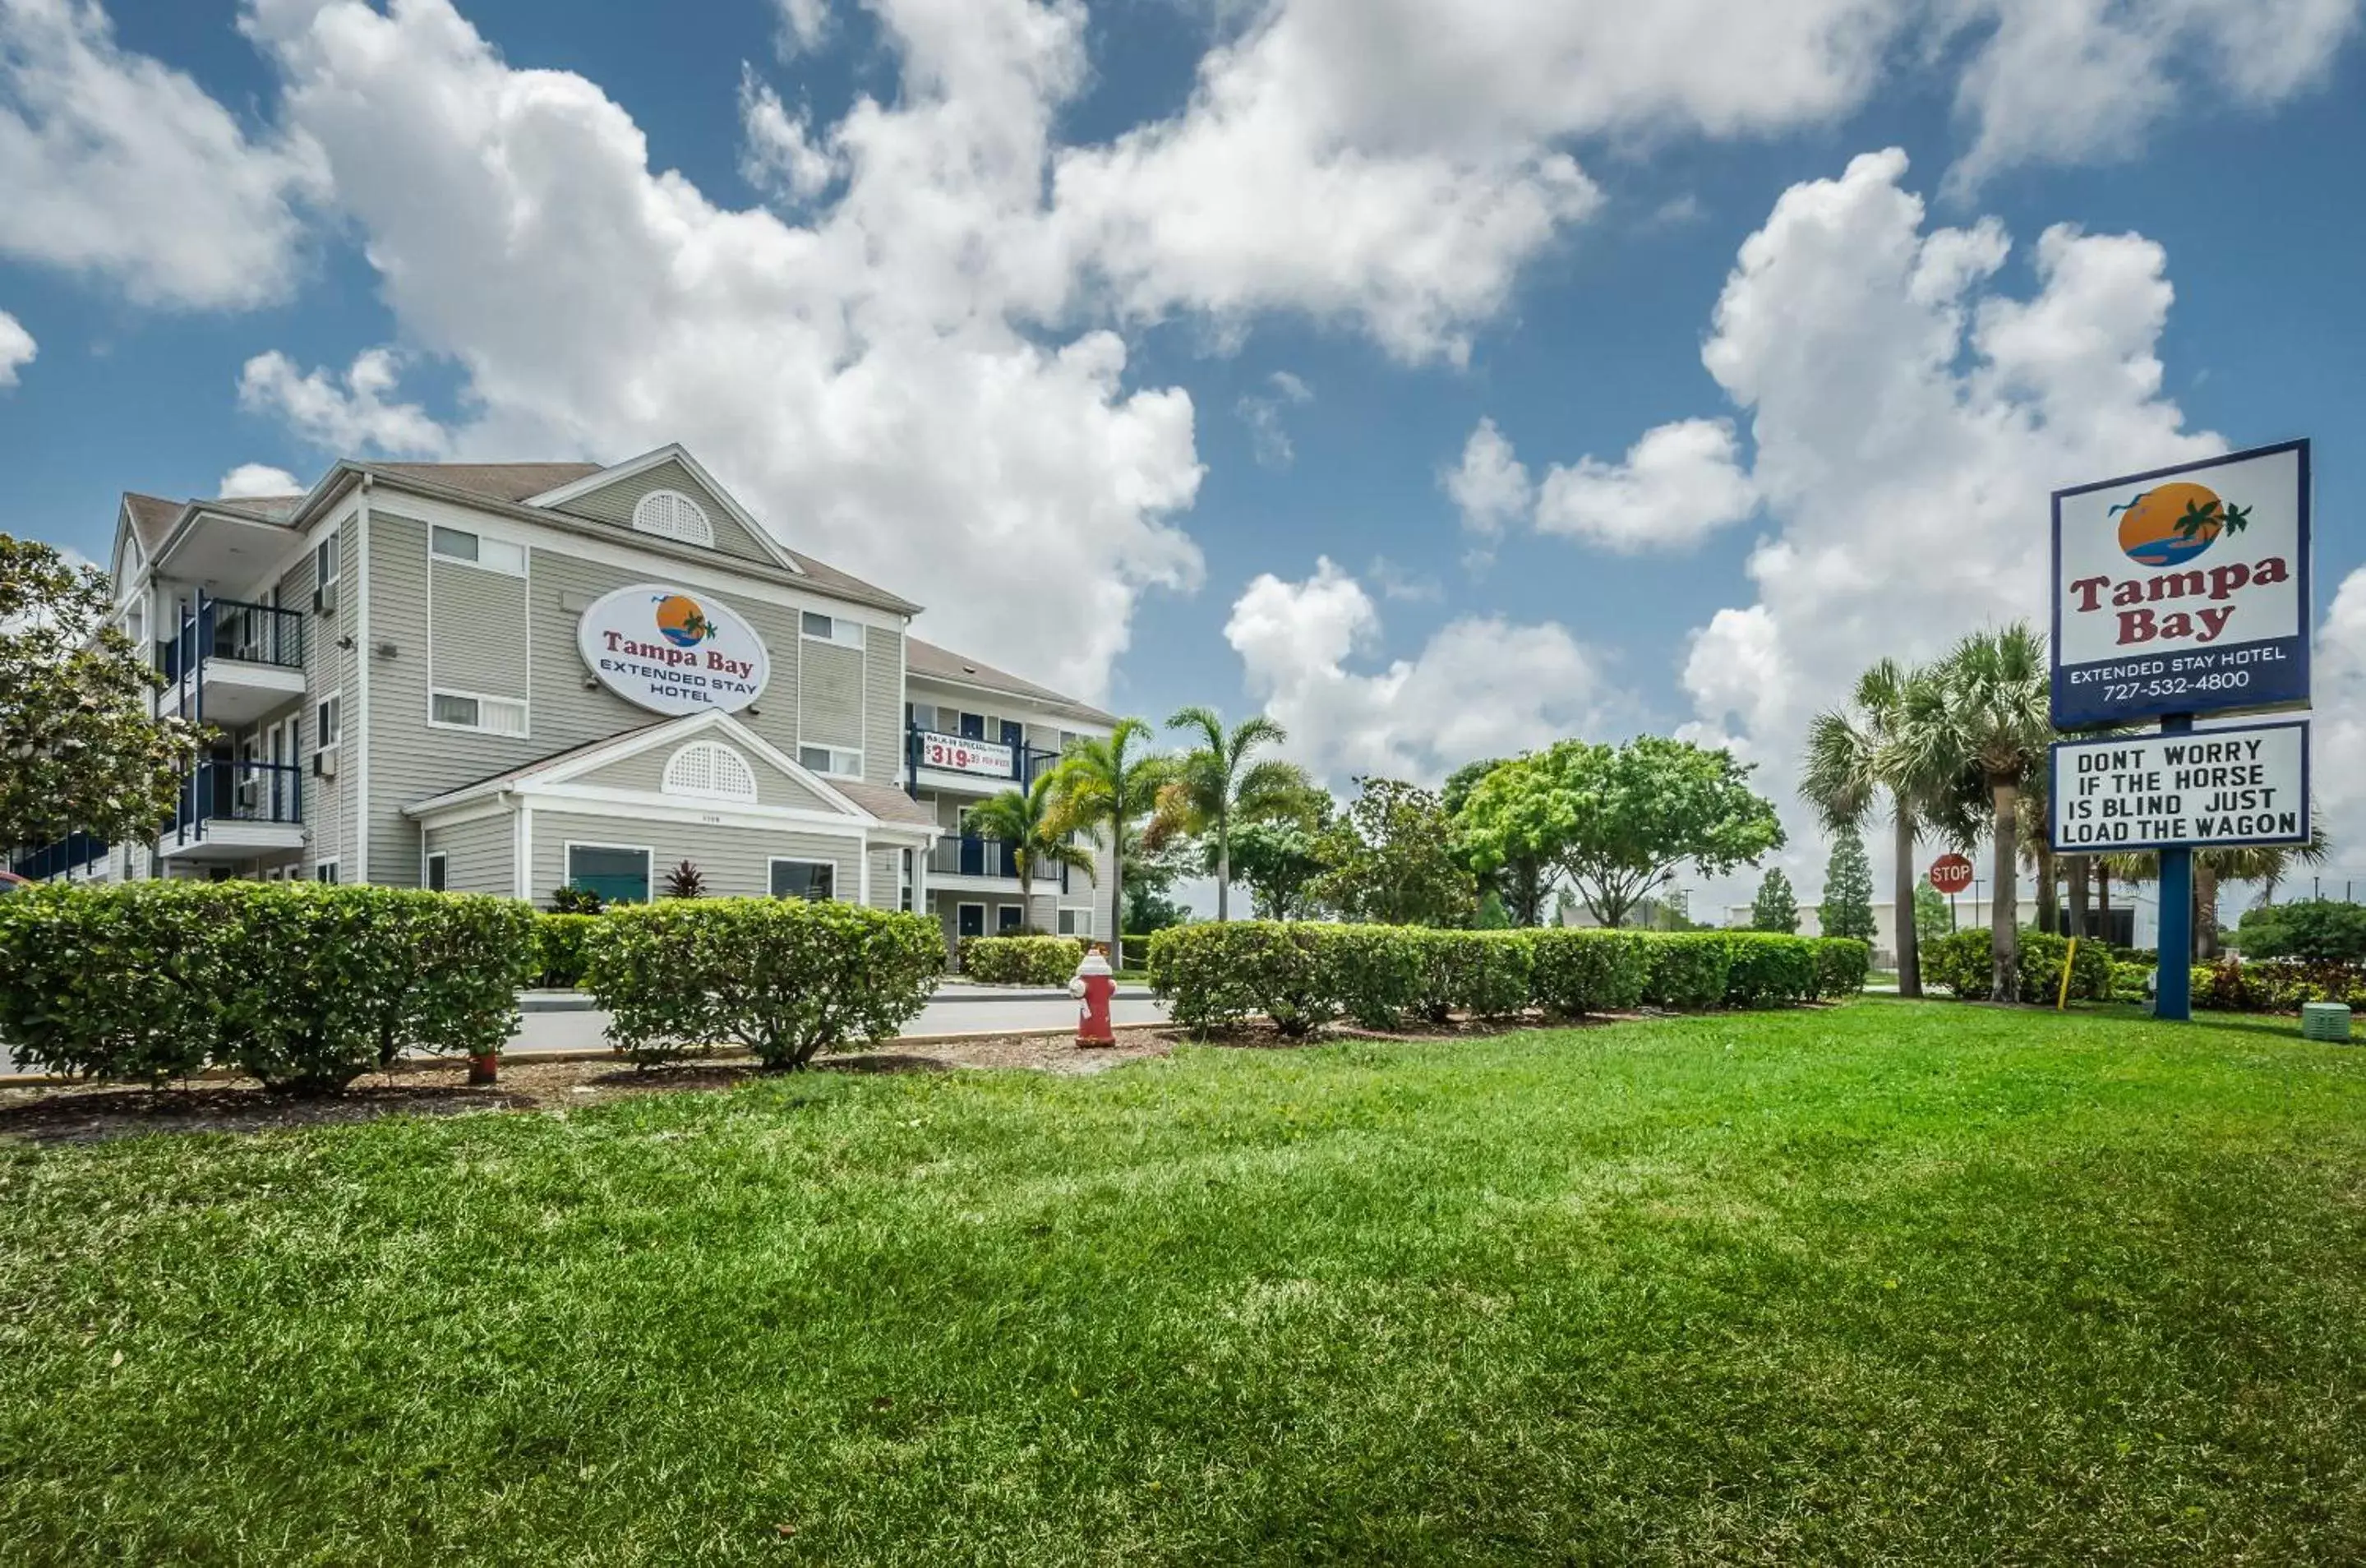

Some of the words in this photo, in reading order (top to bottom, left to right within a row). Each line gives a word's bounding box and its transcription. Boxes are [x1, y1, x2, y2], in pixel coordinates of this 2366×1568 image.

[2069, 556, 2290, 612] Tampa
[2115, 606, 2235, 645] Bay
[603, 630, 698, 667] Tampa
[706, 650, 754, 679] Bay
[2070, 662, 2165, 685] EXTENDED
[2170, 655, 2216, 672] STAY
[2221, 647, 2286, 665] HOTEL
[600, 658, 706, 687] EXTENDED
[712, 679, 757, 694] STAY
[2103, 671, 2249, 702] 727-532-4800
[651, 683, 713, 703] HOTEL
[2078, 749, 2146, 773] DONT
[2164, 740, 2262, 765] WORRY
[2079, 777, 2100, 796] IF
[2112, 772, 2161, 794] THE
[2175, 764, 2264, 790] HORSE
[2069, 800, 2092, 820] IS
[2102, 795, 2181, 818] BLIND
[2205, 788, 2276, 813] JUST
[2063, 822, 2128, 843] LOAD
[2137, 819, 2187, 839] THE
[2195, 812, 2296, 838] WAGON
[1933, 865, 1969, 882] STOP
